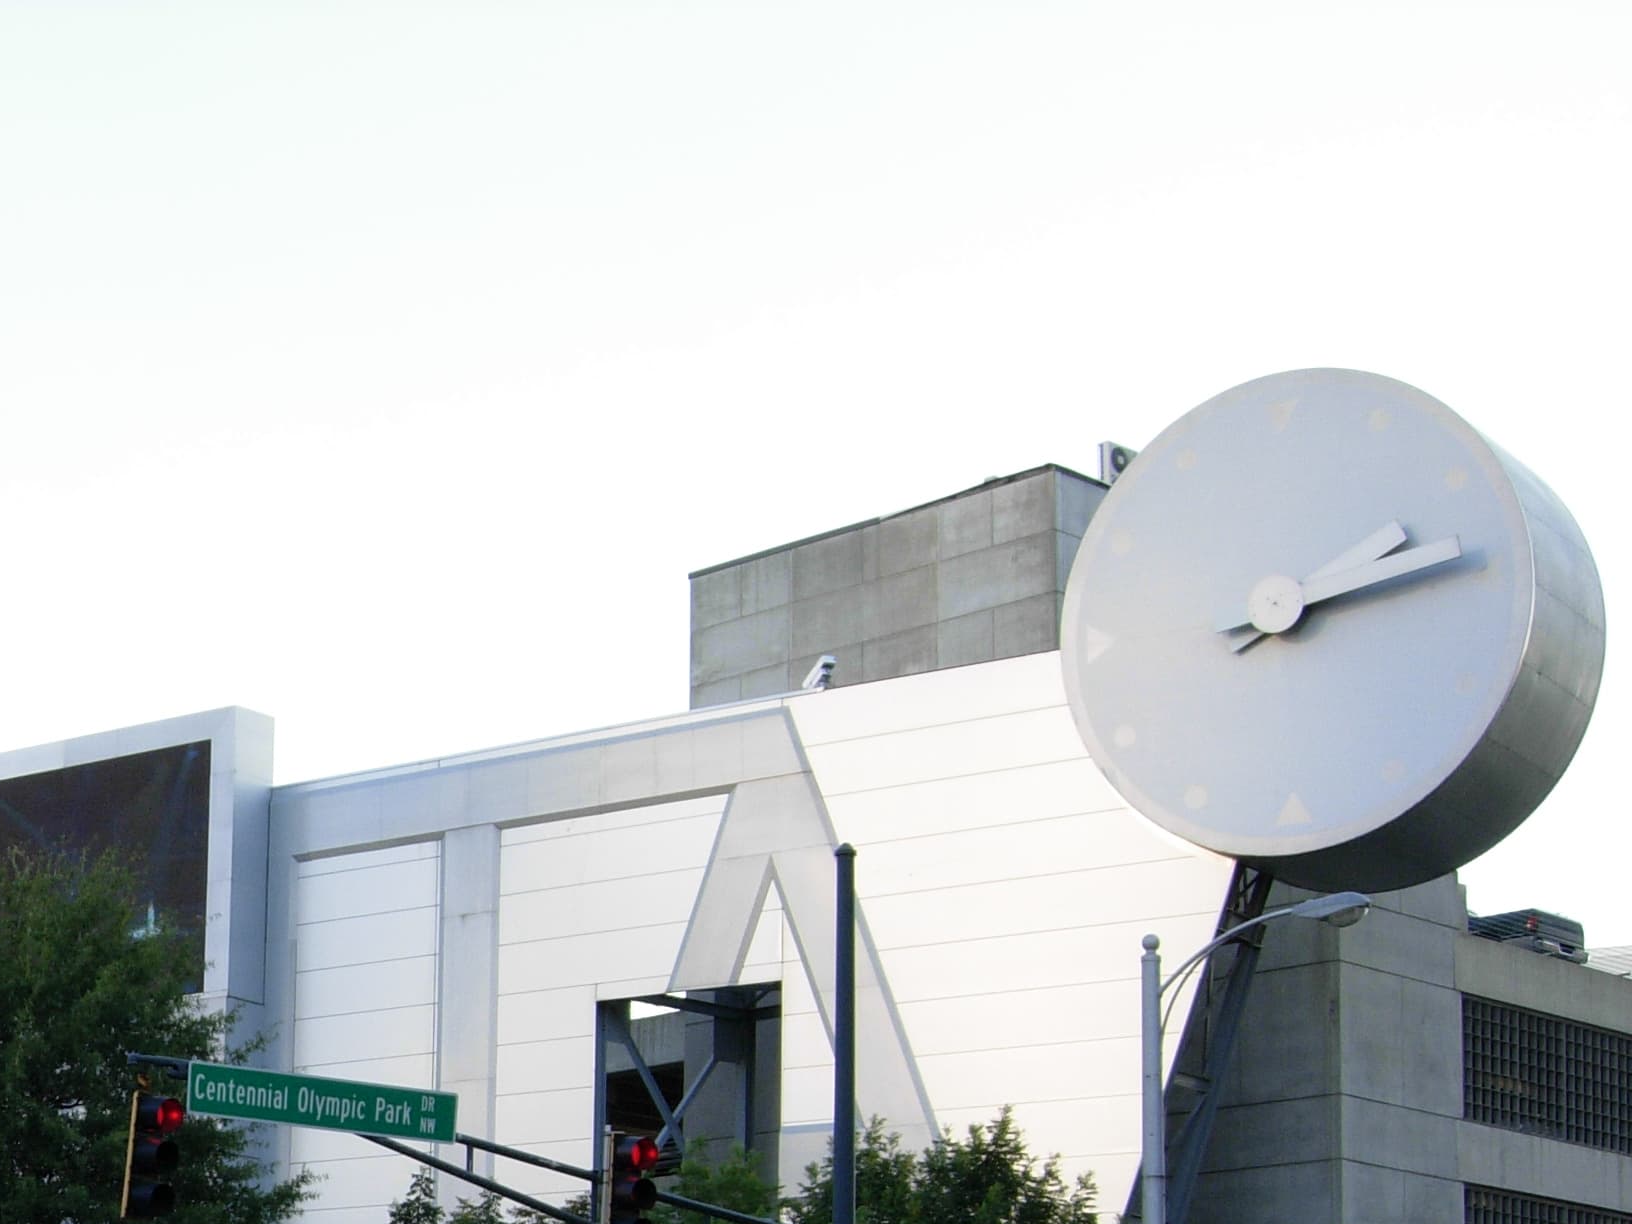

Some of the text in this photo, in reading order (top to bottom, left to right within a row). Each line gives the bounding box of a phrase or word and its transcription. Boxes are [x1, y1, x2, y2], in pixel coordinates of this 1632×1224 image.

[194, 1073, 411, 1125] Centennial Olympic Park
[421, 1095, 435, 1113] DR
[419, 1117, 435, 1134] NW
